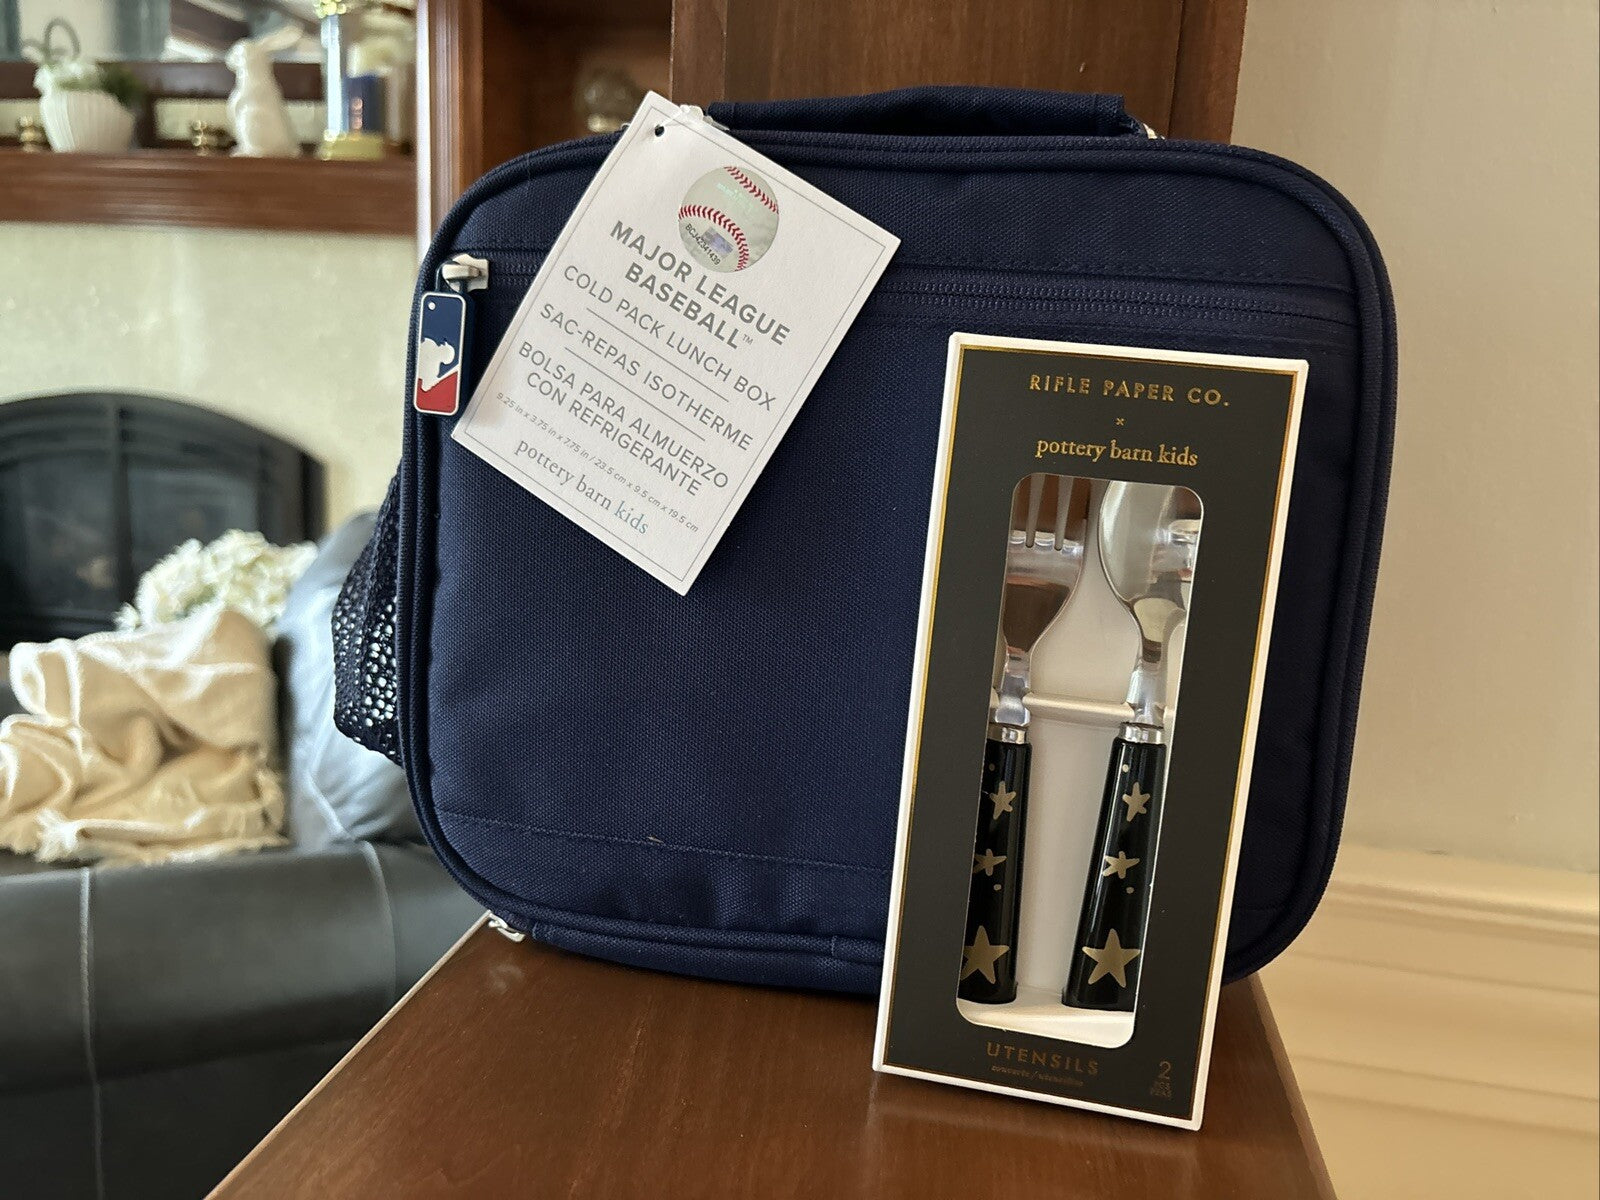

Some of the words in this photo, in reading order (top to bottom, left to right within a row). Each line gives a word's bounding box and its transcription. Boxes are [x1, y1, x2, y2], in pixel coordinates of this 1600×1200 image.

[564, 265, 614, 303] COLD
[616, 297, 665, 339] PACK
[666, 331, 732, 383] LUNCH
[733, 375, 776, 412] BOX
[610, 220, 692, 283] MAJOR
[695, 273, 790, 345] LEAGUE
[519, 341, 576, 390] BOLSA
[578, 382, 630, 424] PARA
[628, 417, 729, 490] ALMUERZO
[526, 371, 568, 405] CON
[568, 399, 703, 496] REFRIGERANTE
[540, 303, 642, 377] SAC-REPAS
[643, 371, 754, 451] ISOTHERME
[1029, 374, 1091, 395] RIFLE
[1103, 380, 1174, 402] PAPER
[1187, 387, 1229, 407] CO.
[496, 392, 516, 408] 9.25
[515, 405, 524, 415] in
[529, 414, 550, 434] 3.75
[547, 427, 557, 437] in
[563, 437, 581, 456] 7.75
[579, 448, 590, 461] in
[594, 457, 616, 477] 23.5
[613, 470, 628, 487] cm
[632, 484, 650, 500] 9.5
[648, 496, 662, 509] cm
[667, 508, 687, 525] 19.5
[684, 519, 699, 534] cm
[514, 440, 576, 486] pottery
[576, 474, 615, 511] barn
[614, 501, 650, 536] kids
[1034, 439, 1107, 463] pottery
[1109, 439, 1153, 462] barn
[1157, 443, 1199, 467] kids
[986, 1041, 1099, 1076] UTENSILS
[1158, 1061, 1171, 1080] 2
